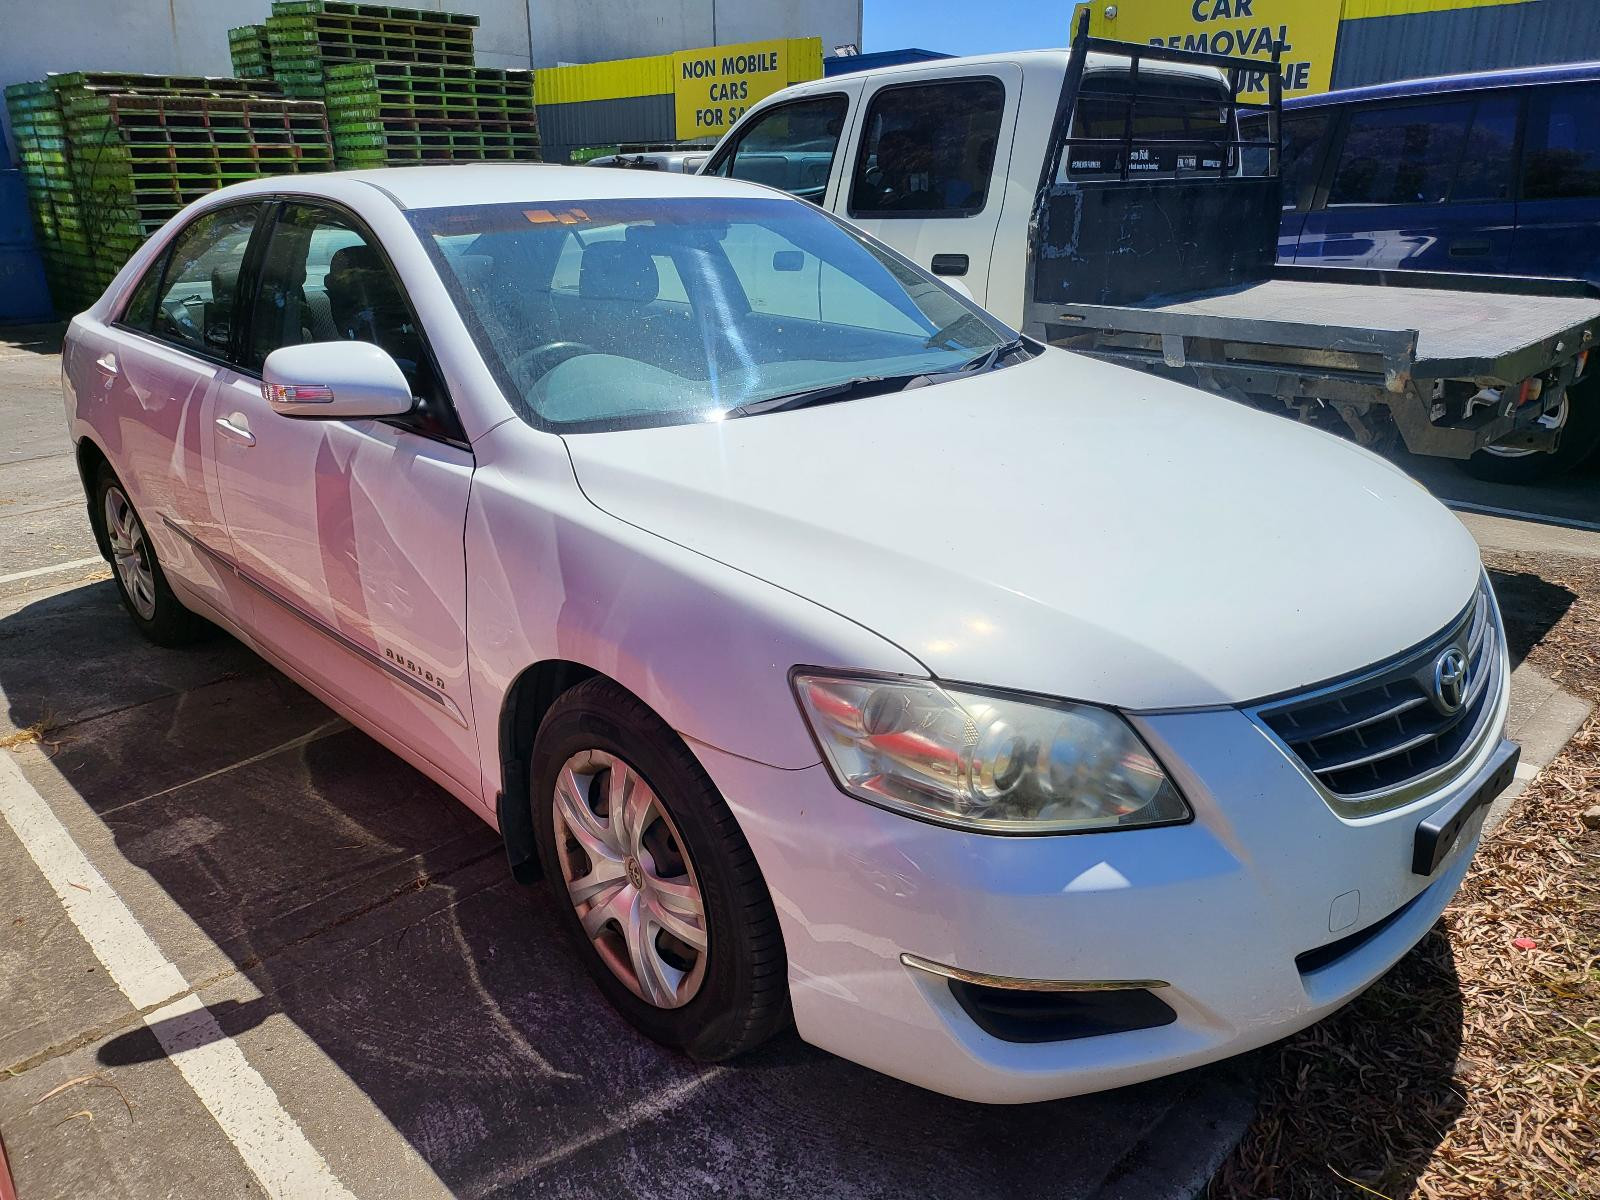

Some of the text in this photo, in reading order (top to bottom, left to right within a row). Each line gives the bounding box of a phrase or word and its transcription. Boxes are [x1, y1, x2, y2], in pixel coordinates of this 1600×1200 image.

[1192, 0, 1253, 22] CAR
[682, 52, 778, 79] NON MOBILE
[710, 81, 748, 101] CARS
[696, 108, 723, 126] FOR
[386, 648, 446, 690] AURION
